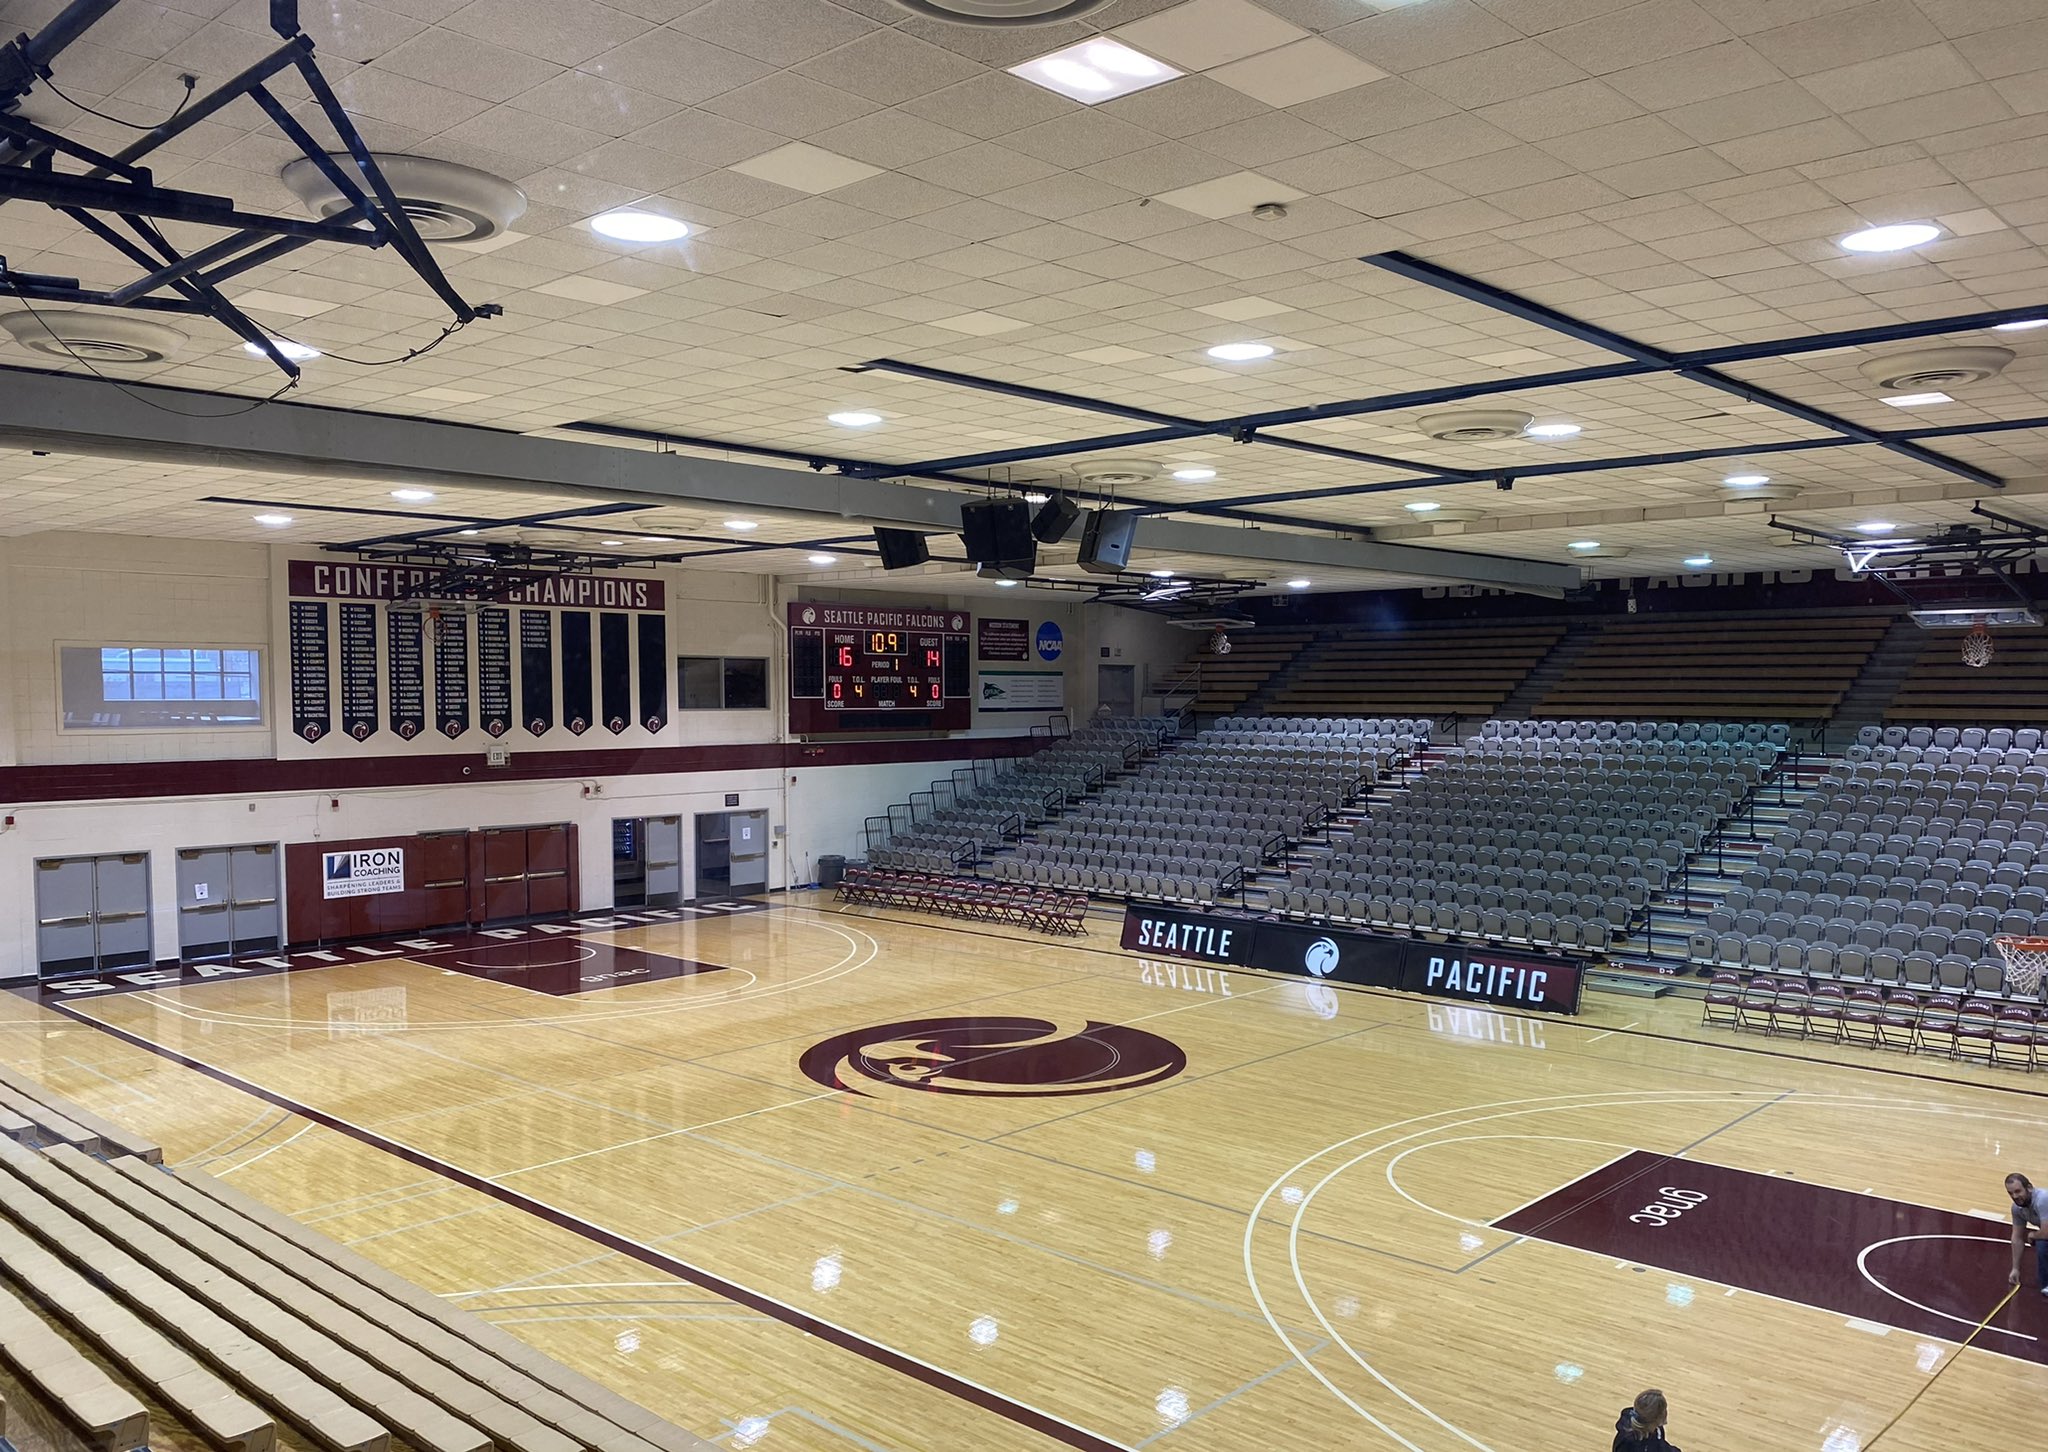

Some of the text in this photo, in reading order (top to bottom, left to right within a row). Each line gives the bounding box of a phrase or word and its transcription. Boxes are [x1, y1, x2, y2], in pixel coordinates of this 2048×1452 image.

[314, 566, 648, 608] CONFEREC CHAMPIONS
[824, 610, 945, 629] SEATTLE PACIFIC FALCONS
[835, 635, 855, 645] HOME
[871, 633, 897, 652] 10.9
[919, 638, 939, 647] GUEST
[1039, 640, 1062, 651] NCAA
[839, 647, 852, 666] 16
[927, 650, 939, 667] 14
[871, 661, 890, 669] PERIOD
[871, 676, 890, 684] PLAYER
[833, 684, 841, 698] 0
[855, 685, 863, 697] 4
[910, 685, 917, 697] 4
[932, 684, 939, 698] 0
[827, 700, 845, 708] SCORE
[878, 700, 895, 708] MATCH
[926, 700, 942, 708] SCORE
[354, 851, 400, 868] IRON
[354, 866, 400, 877] COACHING
[327, 881, 367, 890] SHARPENING
[327, 889, 356, 897] BUILDING
[1138, 919, 1233, 957] SEATTLE
[46, 901, 757, 995] SEATTLE PACIFIC
[1426, 957, 1546, 1002] PACIFIC
[1629, 1187, 1708, 1226] gnac
